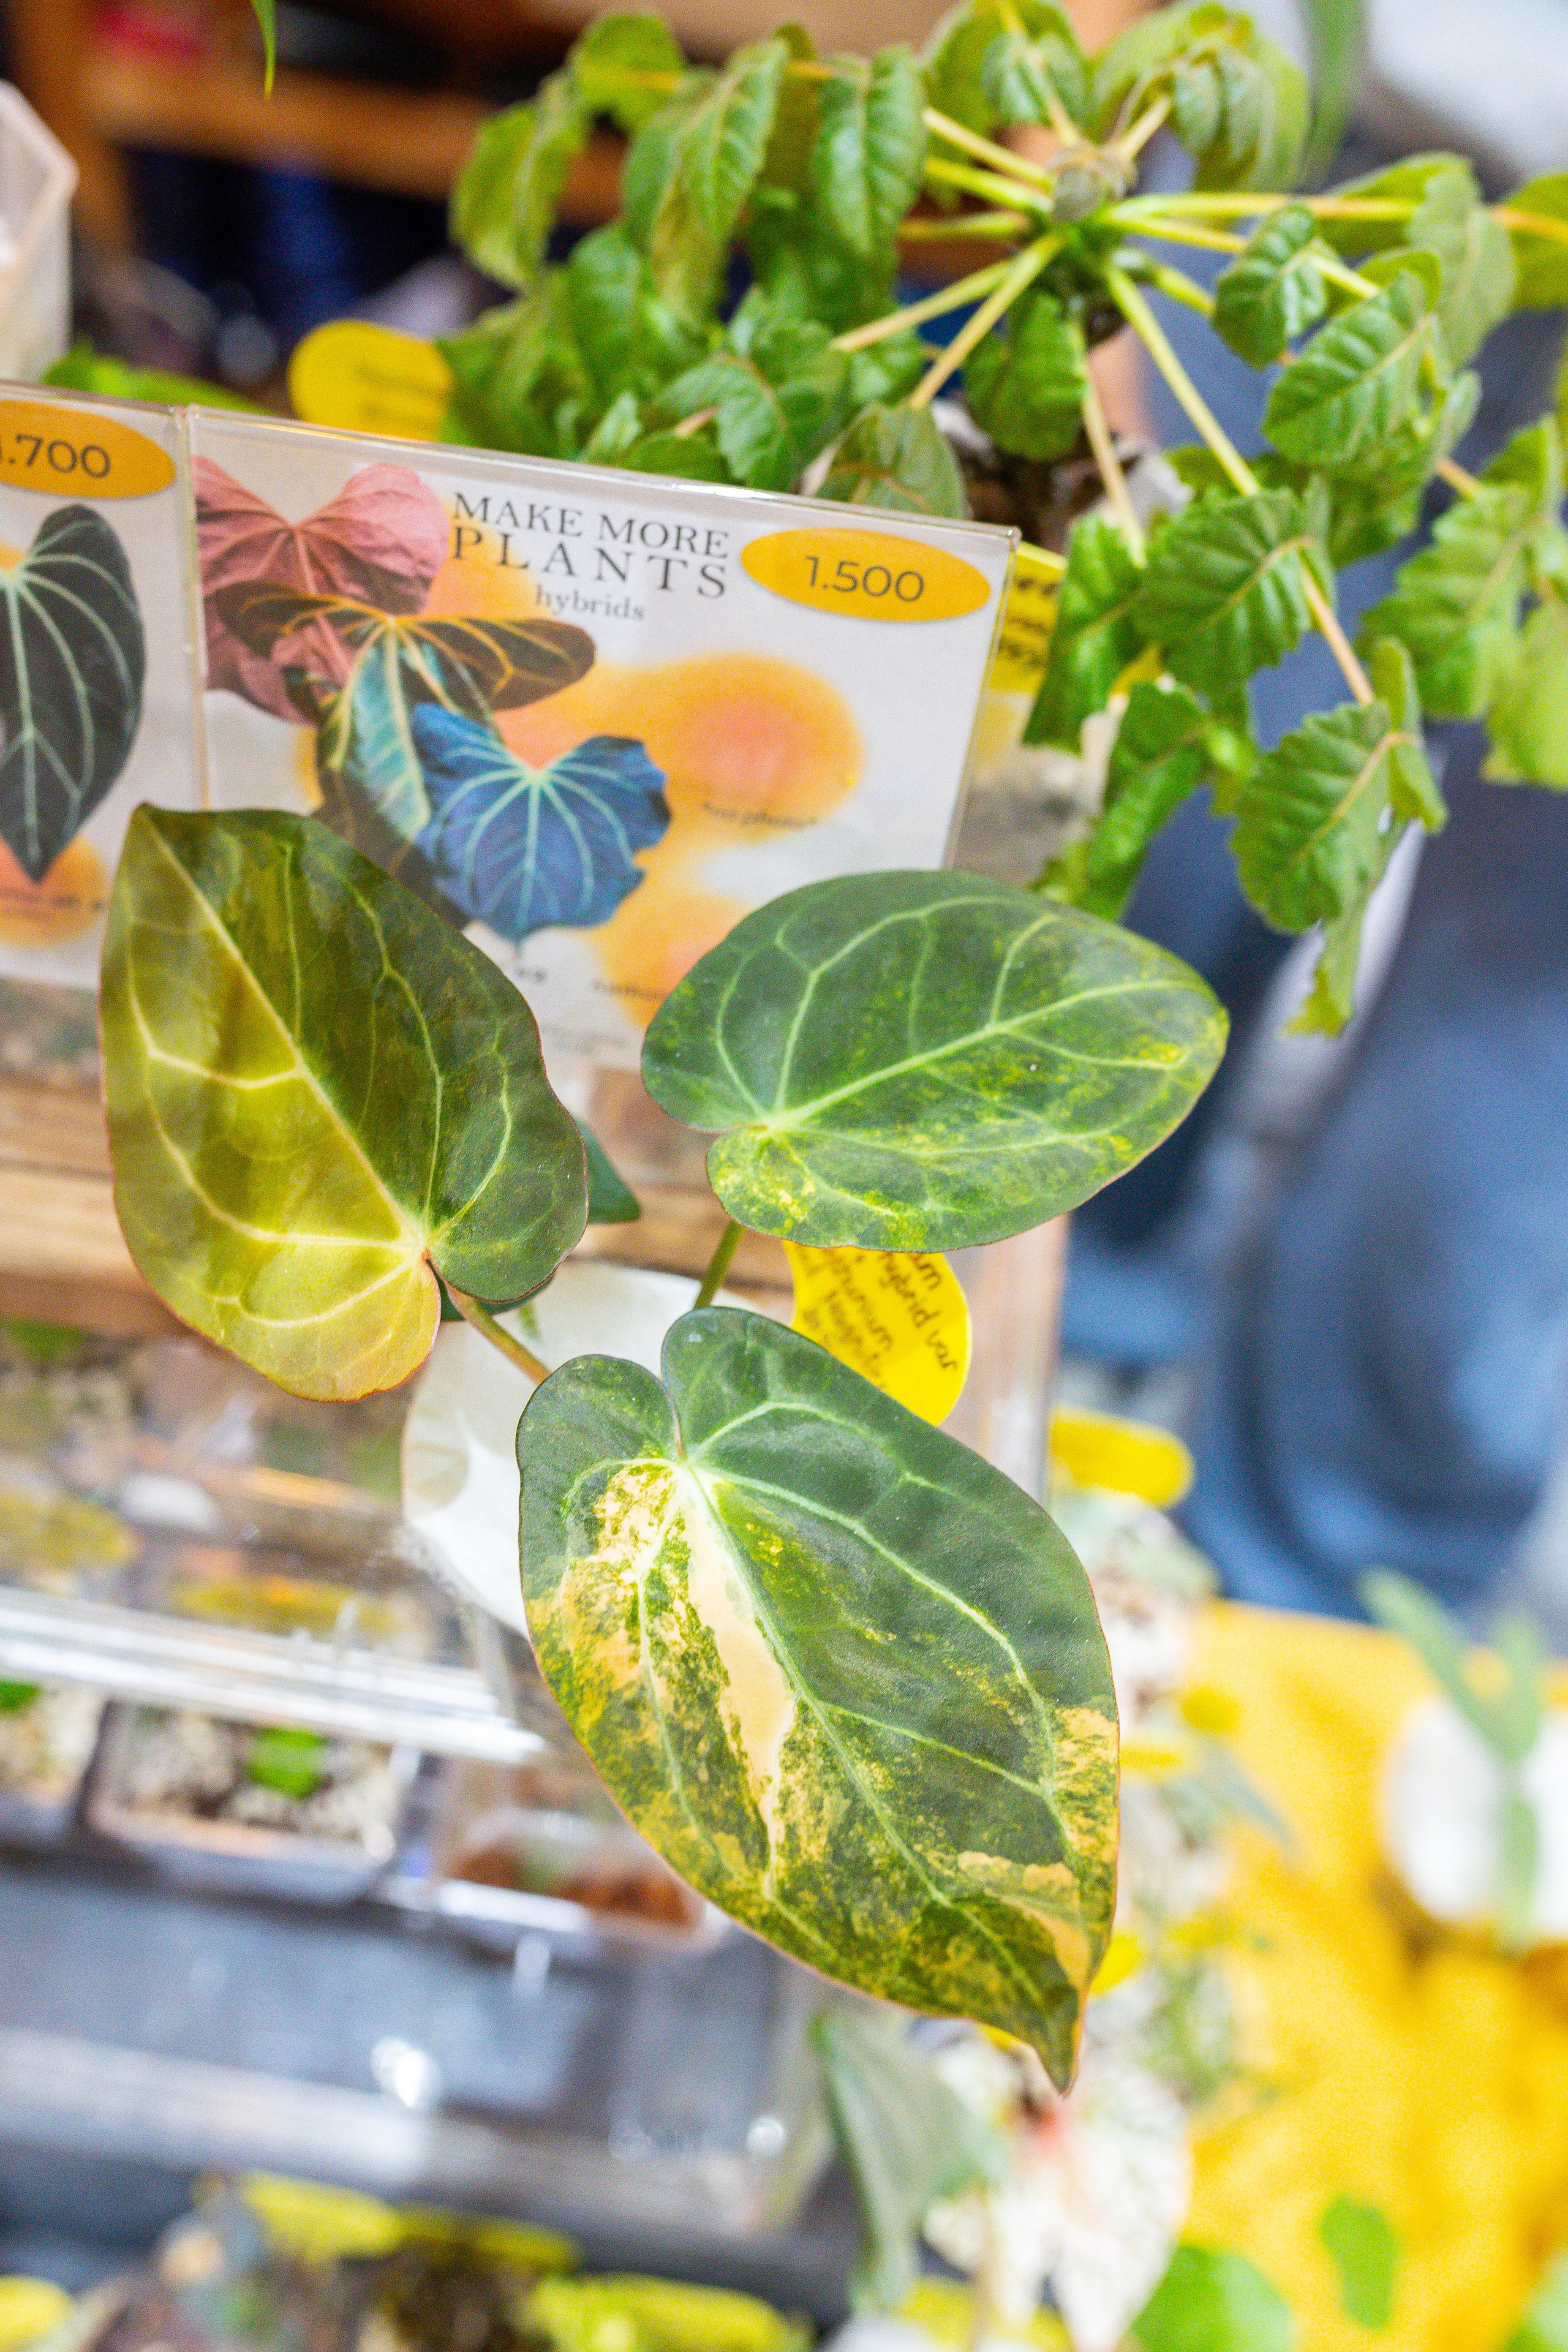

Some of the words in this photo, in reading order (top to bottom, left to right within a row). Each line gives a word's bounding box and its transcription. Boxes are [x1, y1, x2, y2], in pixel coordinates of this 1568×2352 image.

[0, 432, 111, 479] .700
[452, 492, 584, 537] MAKE
[598, 513, 730, 559] MORE
[452, 525, 727, 600] PLANTS
[805, 555, 925, 603] 1.500
[535, 584, 645, 621] hybrids
